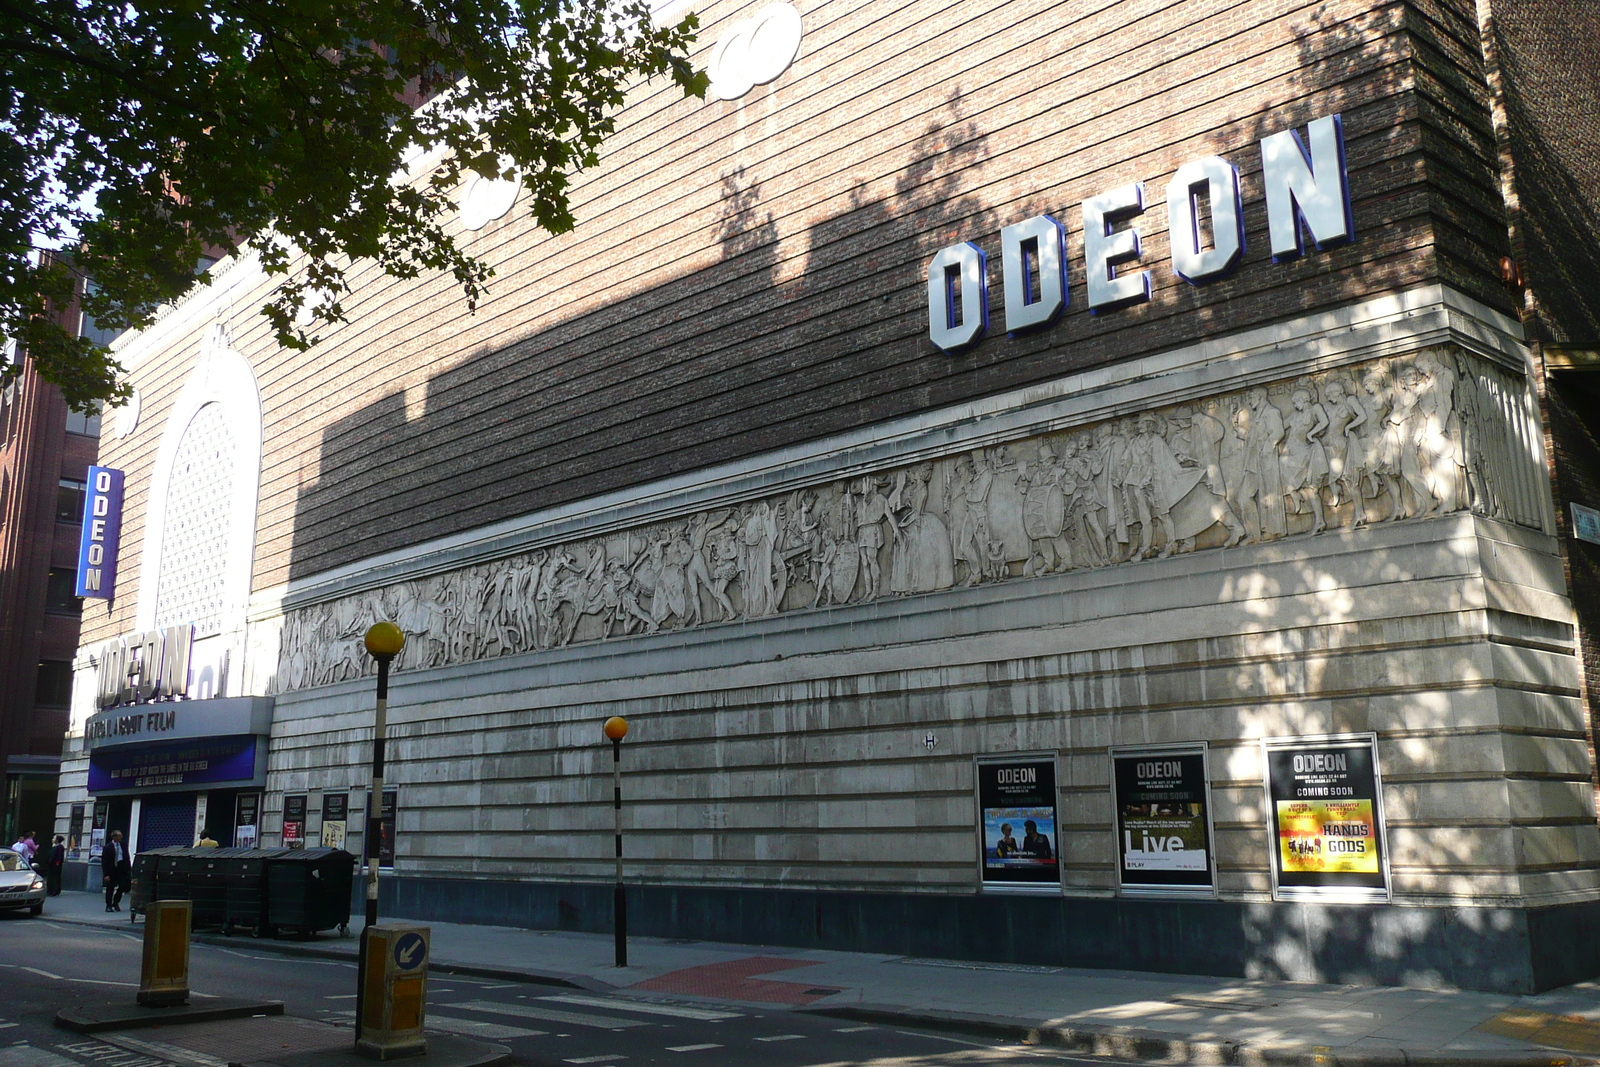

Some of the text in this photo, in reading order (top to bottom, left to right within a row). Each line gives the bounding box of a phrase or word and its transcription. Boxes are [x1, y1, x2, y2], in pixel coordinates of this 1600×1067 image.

[928, 113, 1354, 356] ODEON
[85, 471, 111, 591] ODEON
[97, 623, 194, 709] ODEON
[147, 710, 175, 732] FILM
[1136, 761, 1182, 779] ODEON
[1293, 753, 1347, 773] ODEON
[997, 767, 1037, 784] ODEON
[1140, 791, 1189, 800] COMING SOON
[1297, 786, 1353, 796] COMING SOON
[1323, 825, 1368, 836] HANDS
[1125, 830, 1184, 854] Live
[1328, 840, 1365, 853] GODS
